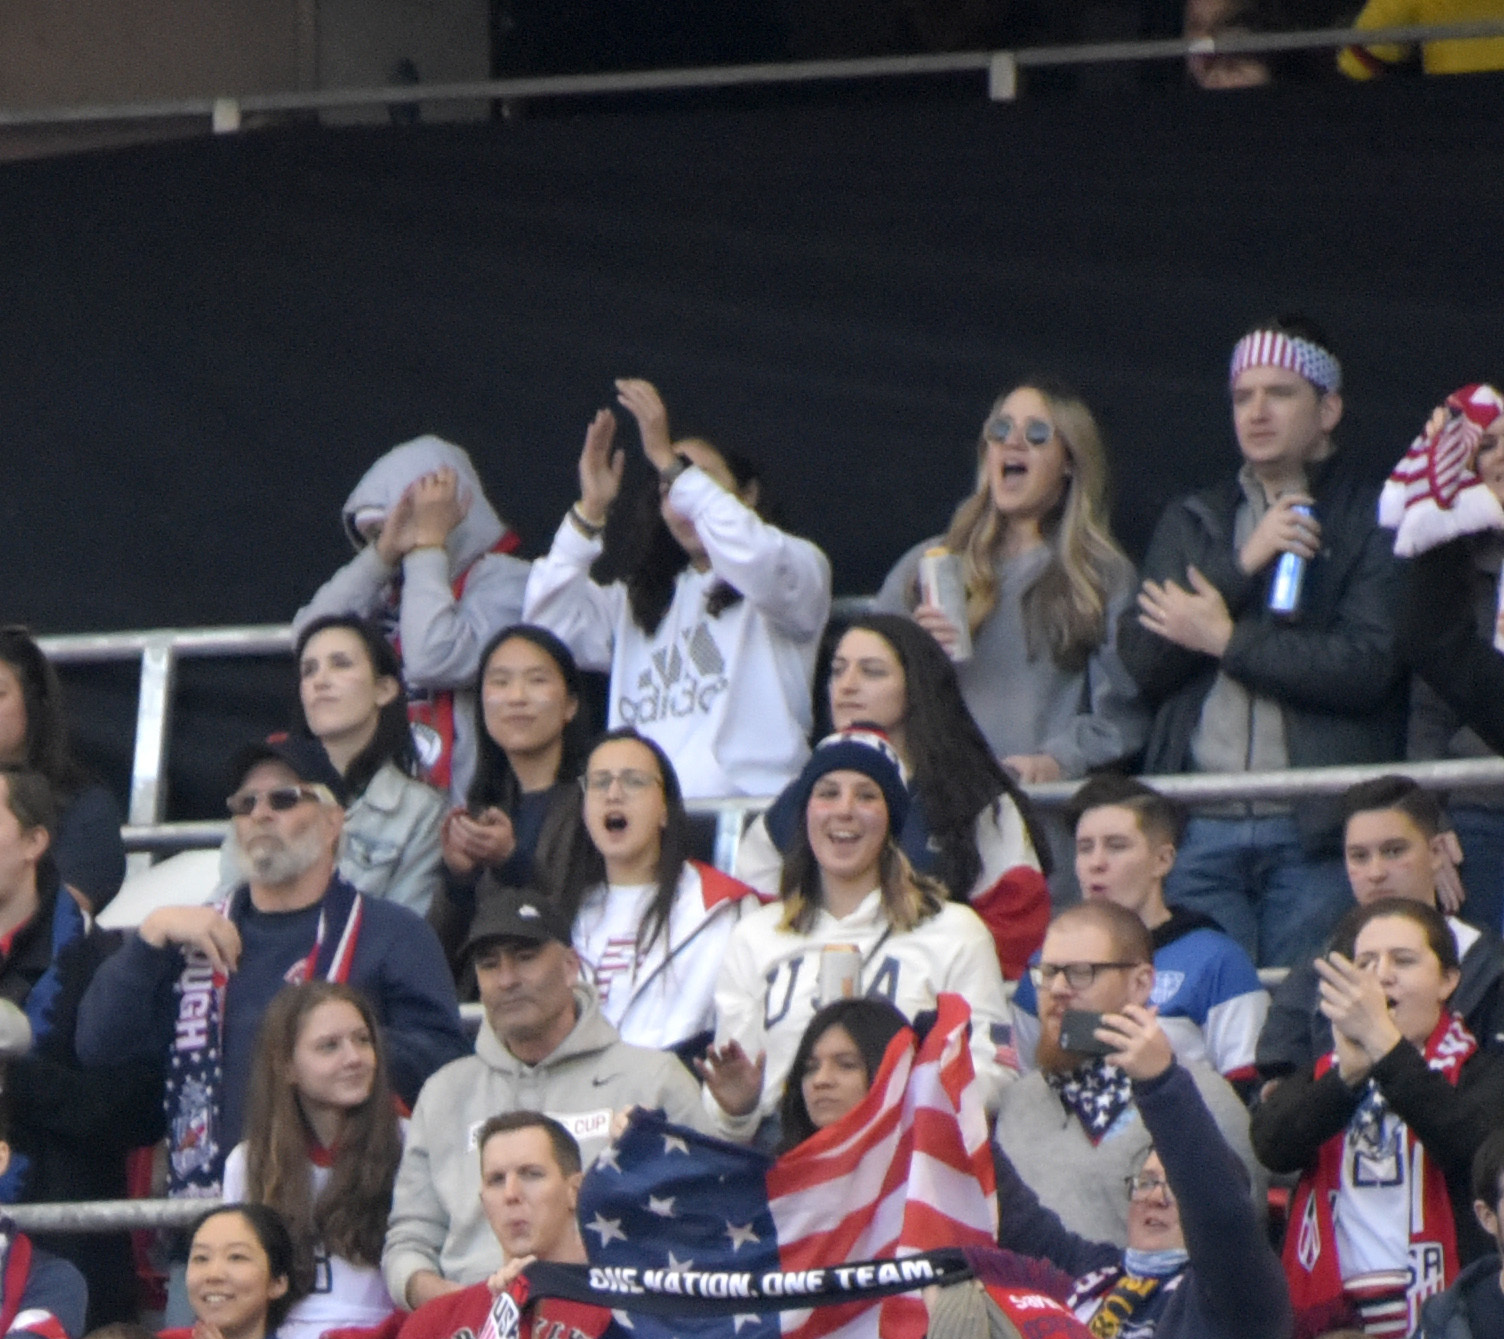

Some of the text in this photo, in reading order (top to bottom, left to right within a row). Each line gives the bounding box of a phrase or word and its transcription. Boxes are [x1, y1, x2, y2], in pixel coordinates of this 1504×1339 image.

[618, 672, 730, 726] adidas
[764, 953, 905, 1031] UA
[573, 1118, 607, 1139] CUP
[589, 1258, 945, 1300] ONE NATION. ONE TEAM.
